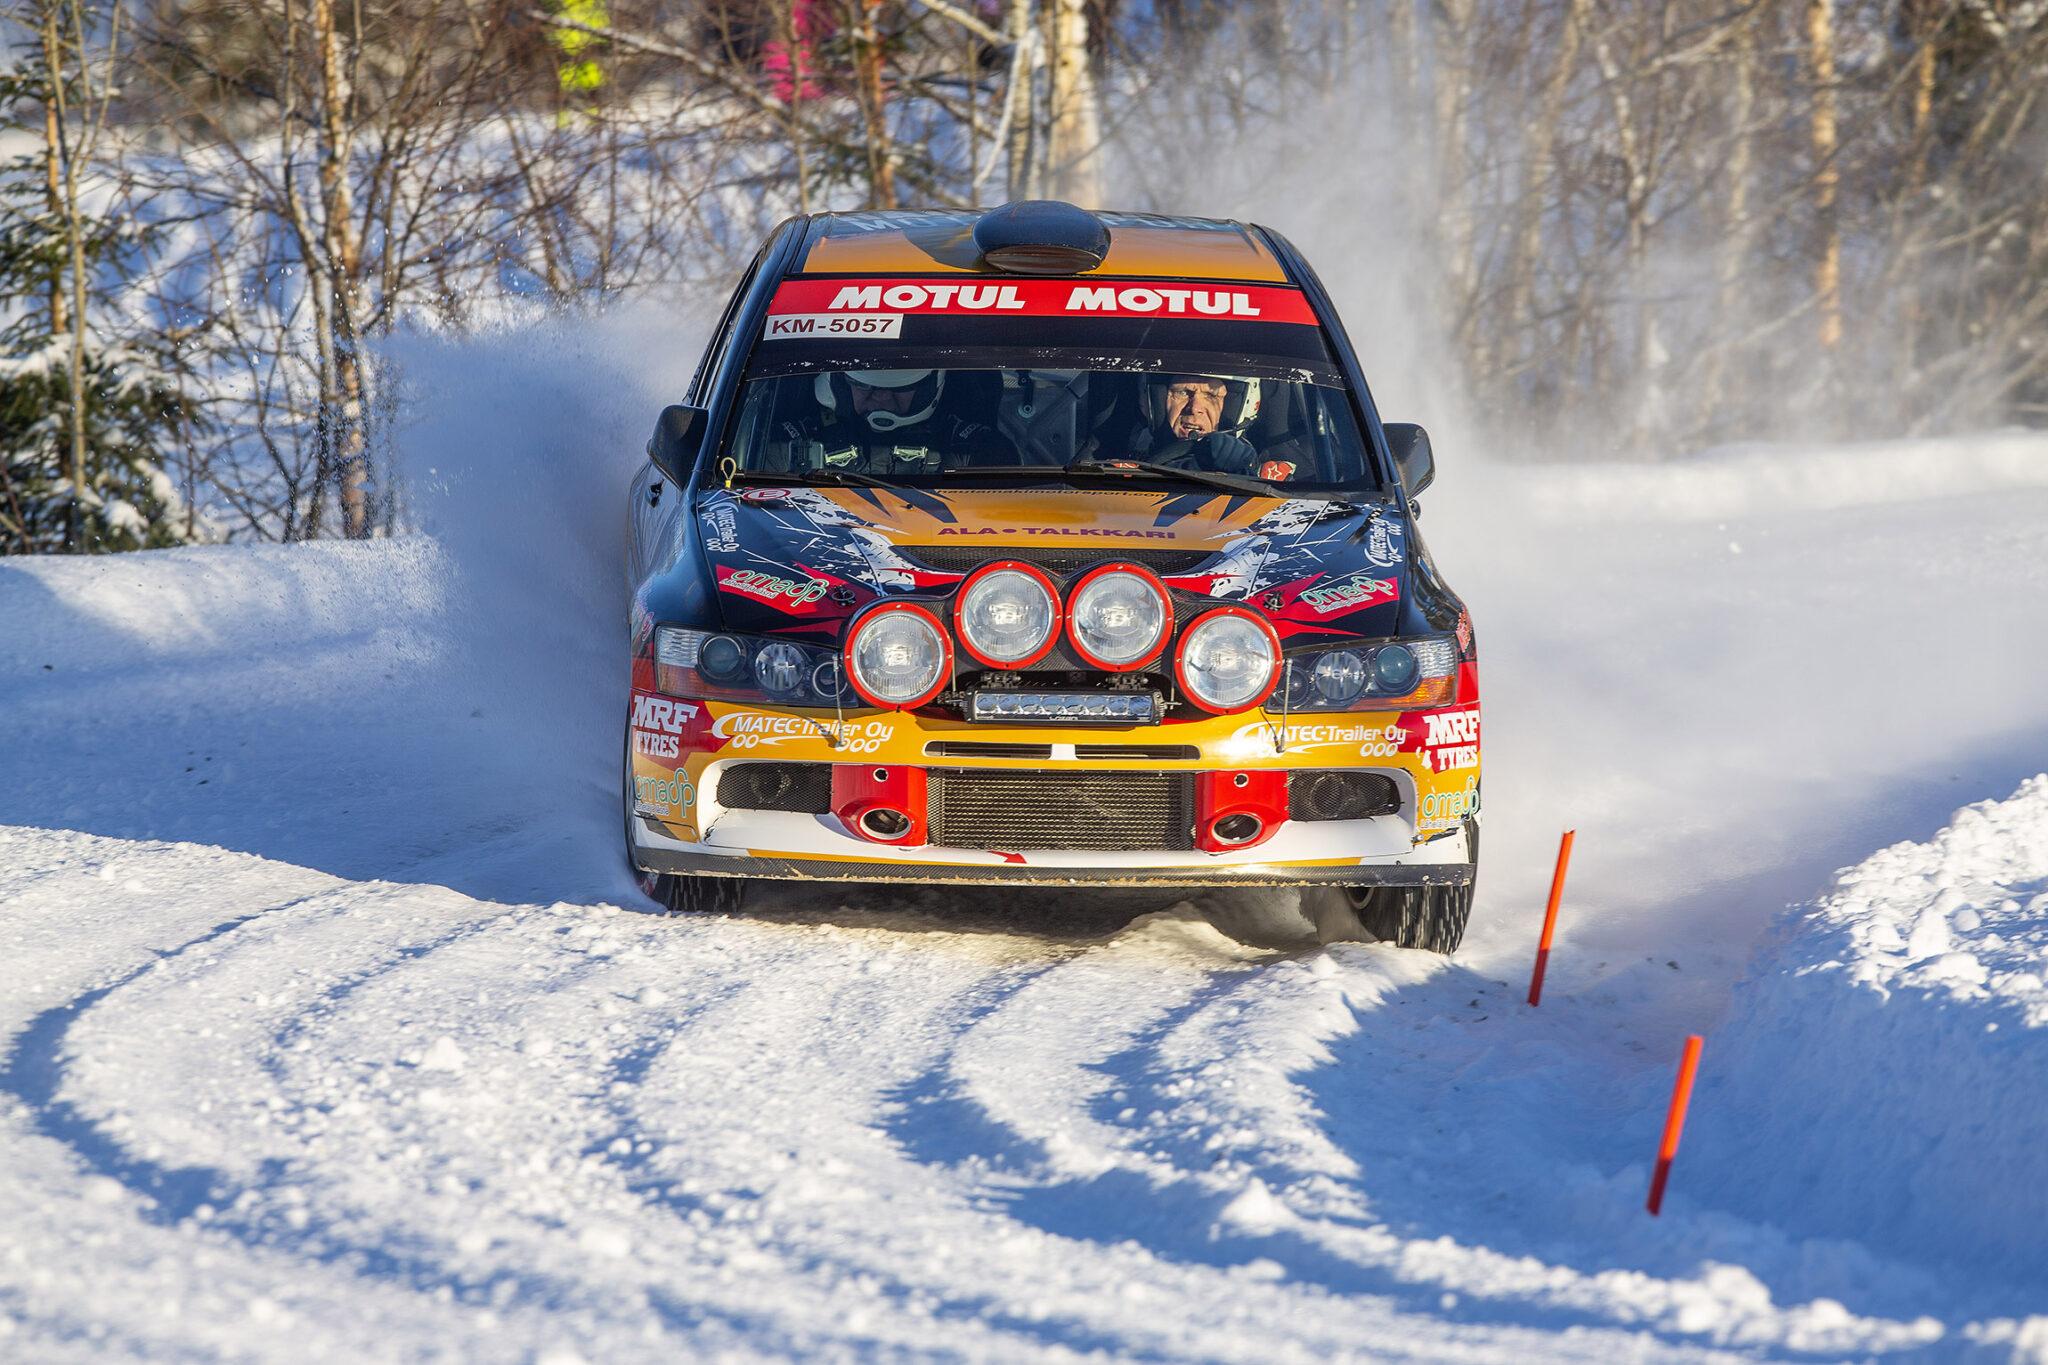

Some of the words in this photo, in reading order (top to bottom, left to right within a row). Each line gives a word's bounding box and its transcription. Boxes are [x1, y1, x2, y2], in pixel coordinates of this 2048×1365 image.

[828, 285, 1026, 311] MOTUL
[1065, 286, 1261, 317] MOTUL
[771, 317, 895, 335] KM-5057
[937, 527, 999, 536] ALA
[1022, 527, 1177, 540] TALKKARI
[632, 695, 699, 735] MRF
[733, 715, 862, 736] MATEC-Trailer
[865, 721, 895, 742] Oy
[1422, 710, 1480, 747] MRF
[635, 731, 680, 759] TYRES
[1257, 724, 1382, 743] MATEC-Trailer
[1384, 724, 1407, 745] Oy
[1437, 745, 1478, 771] TYRES
